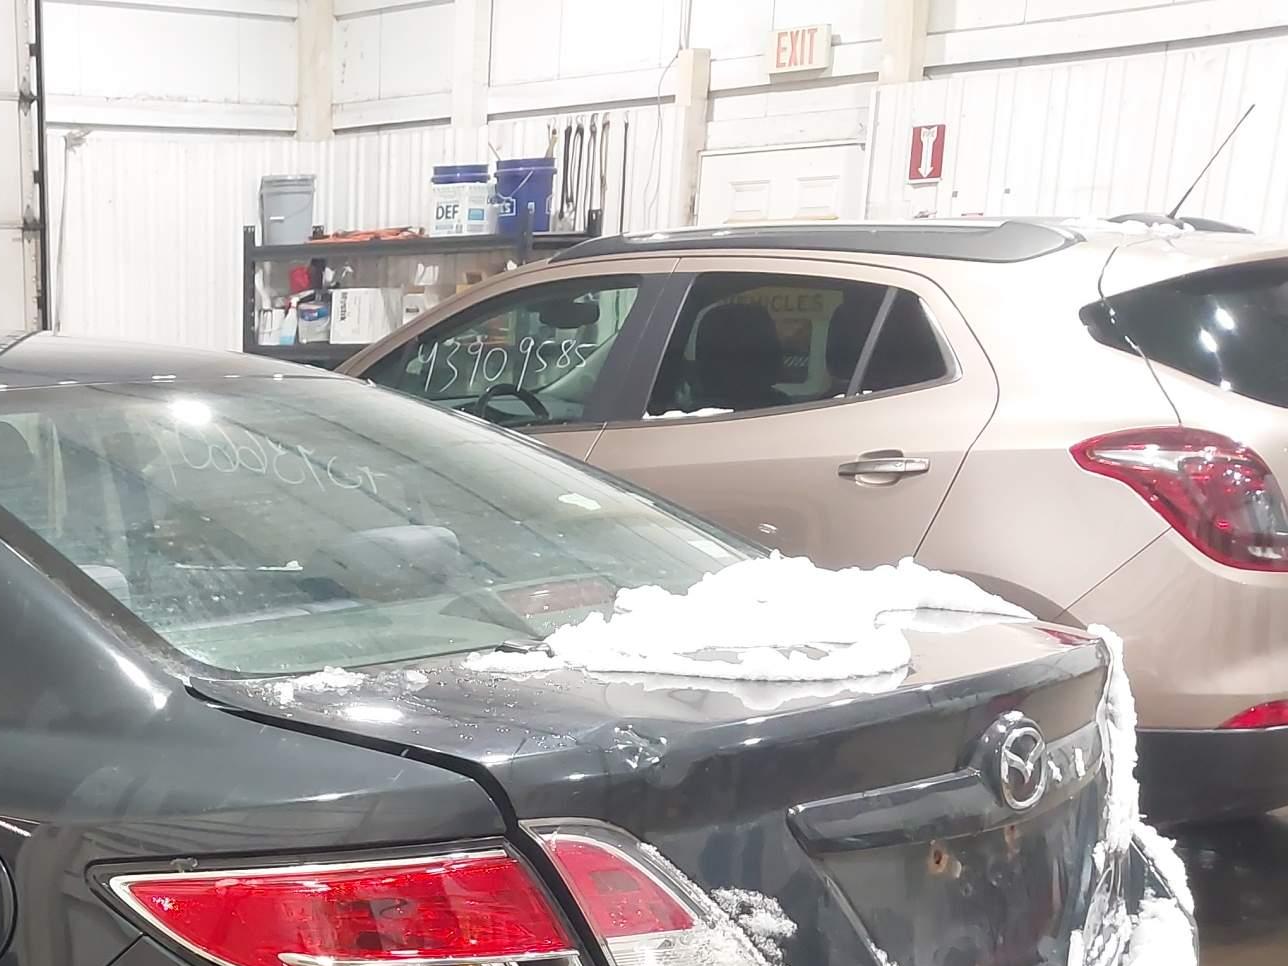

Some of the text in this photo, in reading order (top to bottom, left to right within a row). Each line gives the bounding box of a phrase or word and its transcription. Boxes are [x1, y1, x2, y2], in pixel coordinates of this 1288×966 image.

[775, 27, 818, 68] EXIT
[435, 204, 460, 220] DEF
[417, 336, 599, 392] 43909585
